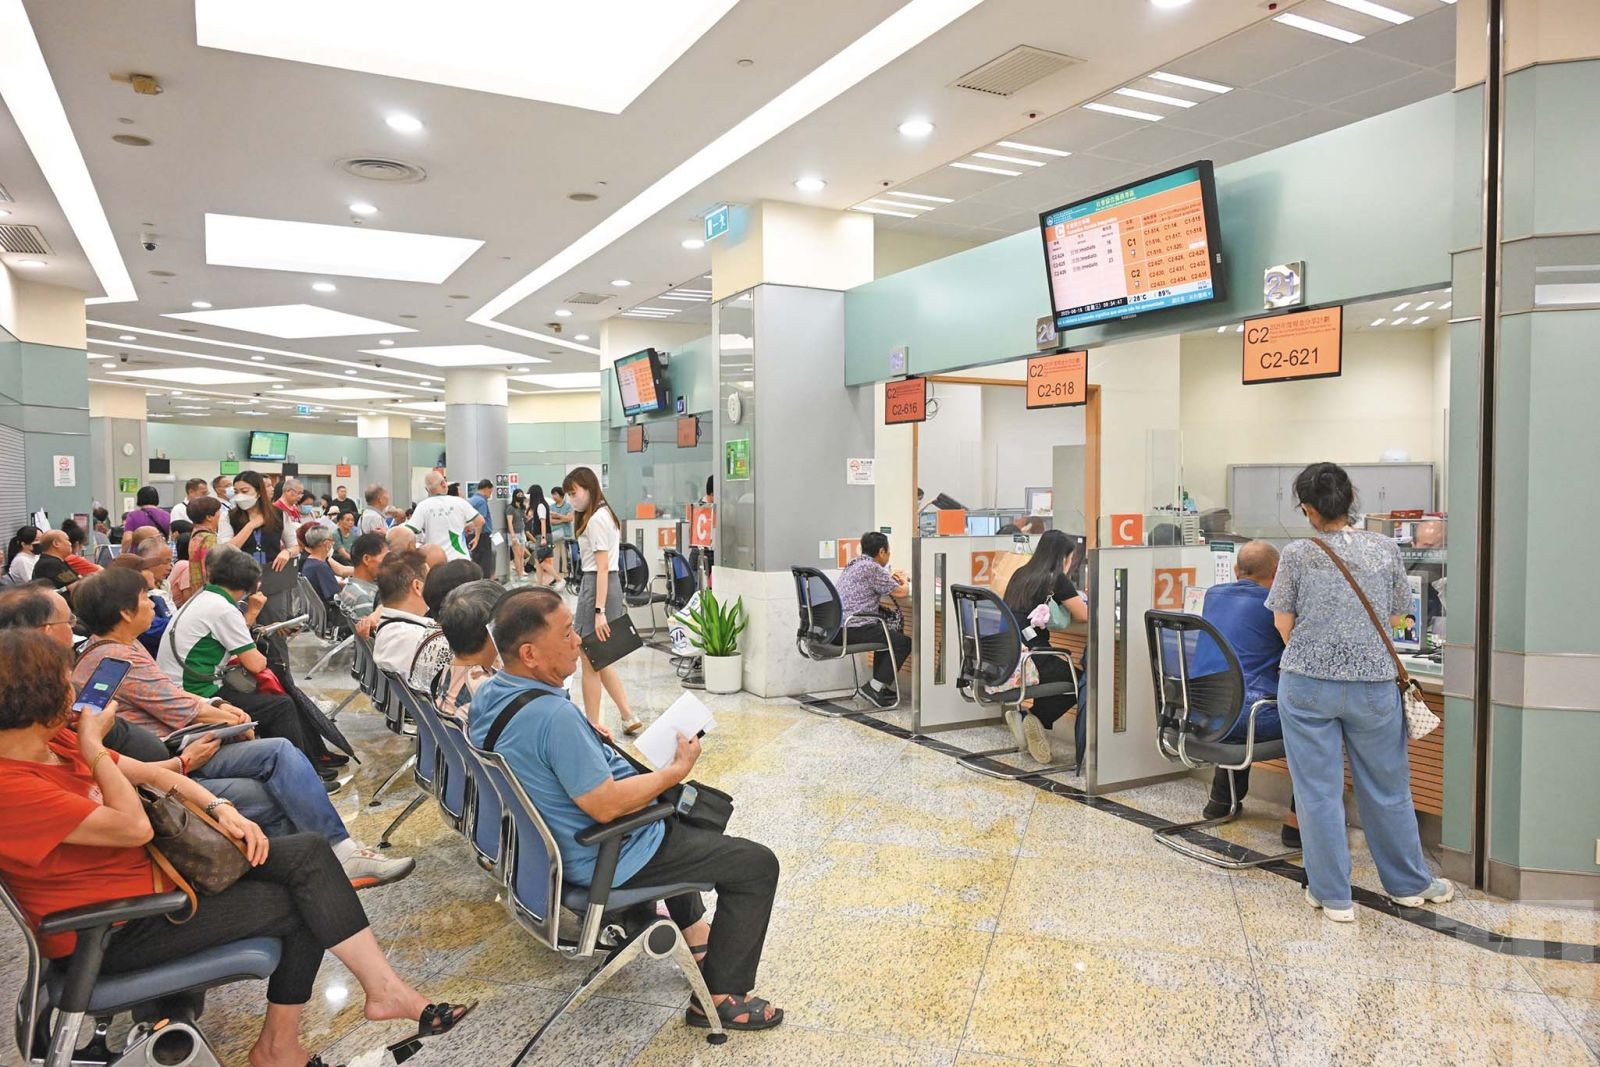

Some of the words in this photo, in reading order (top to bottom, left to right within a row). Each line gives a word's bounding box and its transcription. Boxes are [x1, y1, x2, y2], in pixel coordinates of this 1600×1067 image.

[1127, 238, 1136, 247] C1
[1131, 270, 1140, 278] C2
[1266, 271, 1294, 300] 21
[1248, 327, 1269, 344] C2
[1260, 347, 1318, 369] C2-621
[1030, 364, 1044, 378] C2
[887, 388, 896, 399] C2
[1037, 381, 1074, 398] C2-618
[892, 402, 917, 416] C2-616
[697, 514, 706, 540] C
[1119, 519, 1134, 541] C
[1157, 572, 1189, 605] 21
